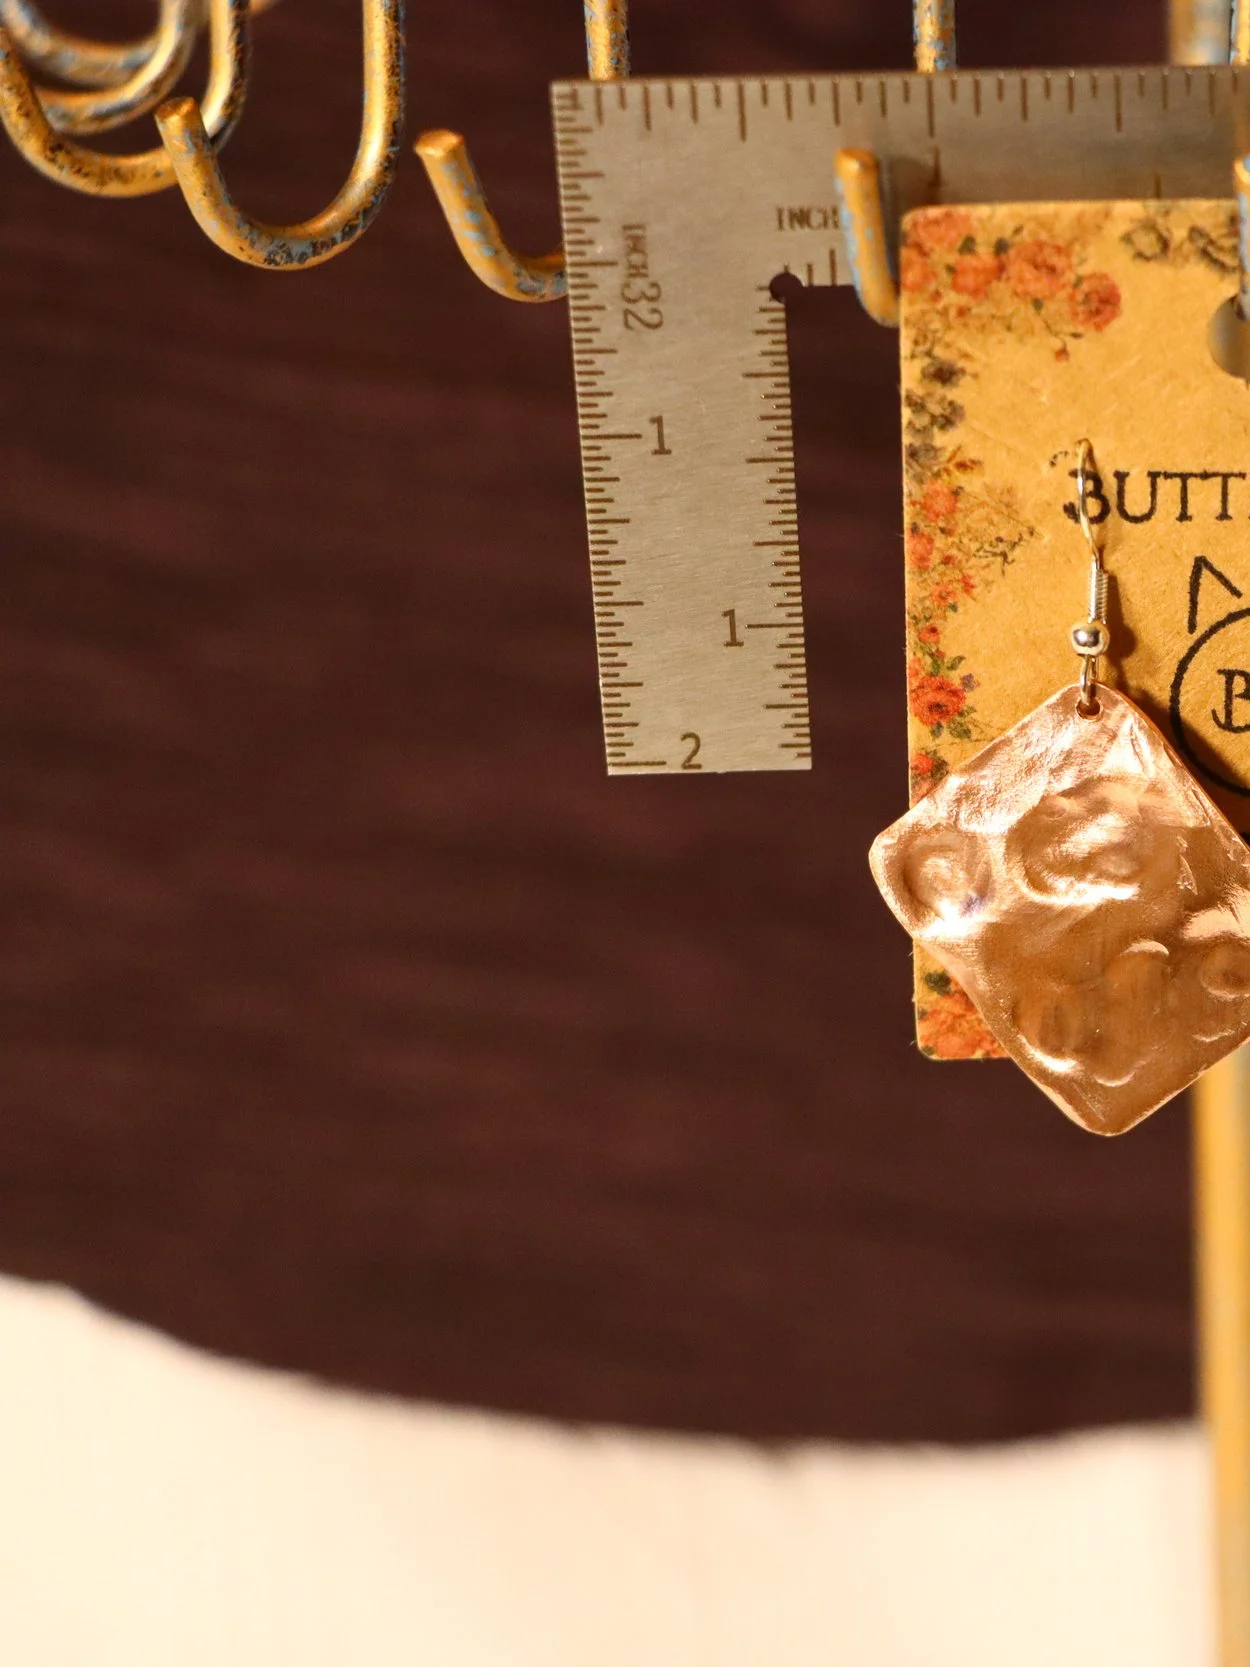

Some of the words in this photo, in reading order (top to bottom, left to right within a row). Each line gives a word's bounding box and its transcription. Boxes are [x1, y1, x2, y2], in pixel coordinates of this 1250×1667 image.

[620, 281, 664, 331] 32
[648, 415, 673, 456] 1
[720, 608, 745, 648] 1
[679, 731, 703, 770] 2
